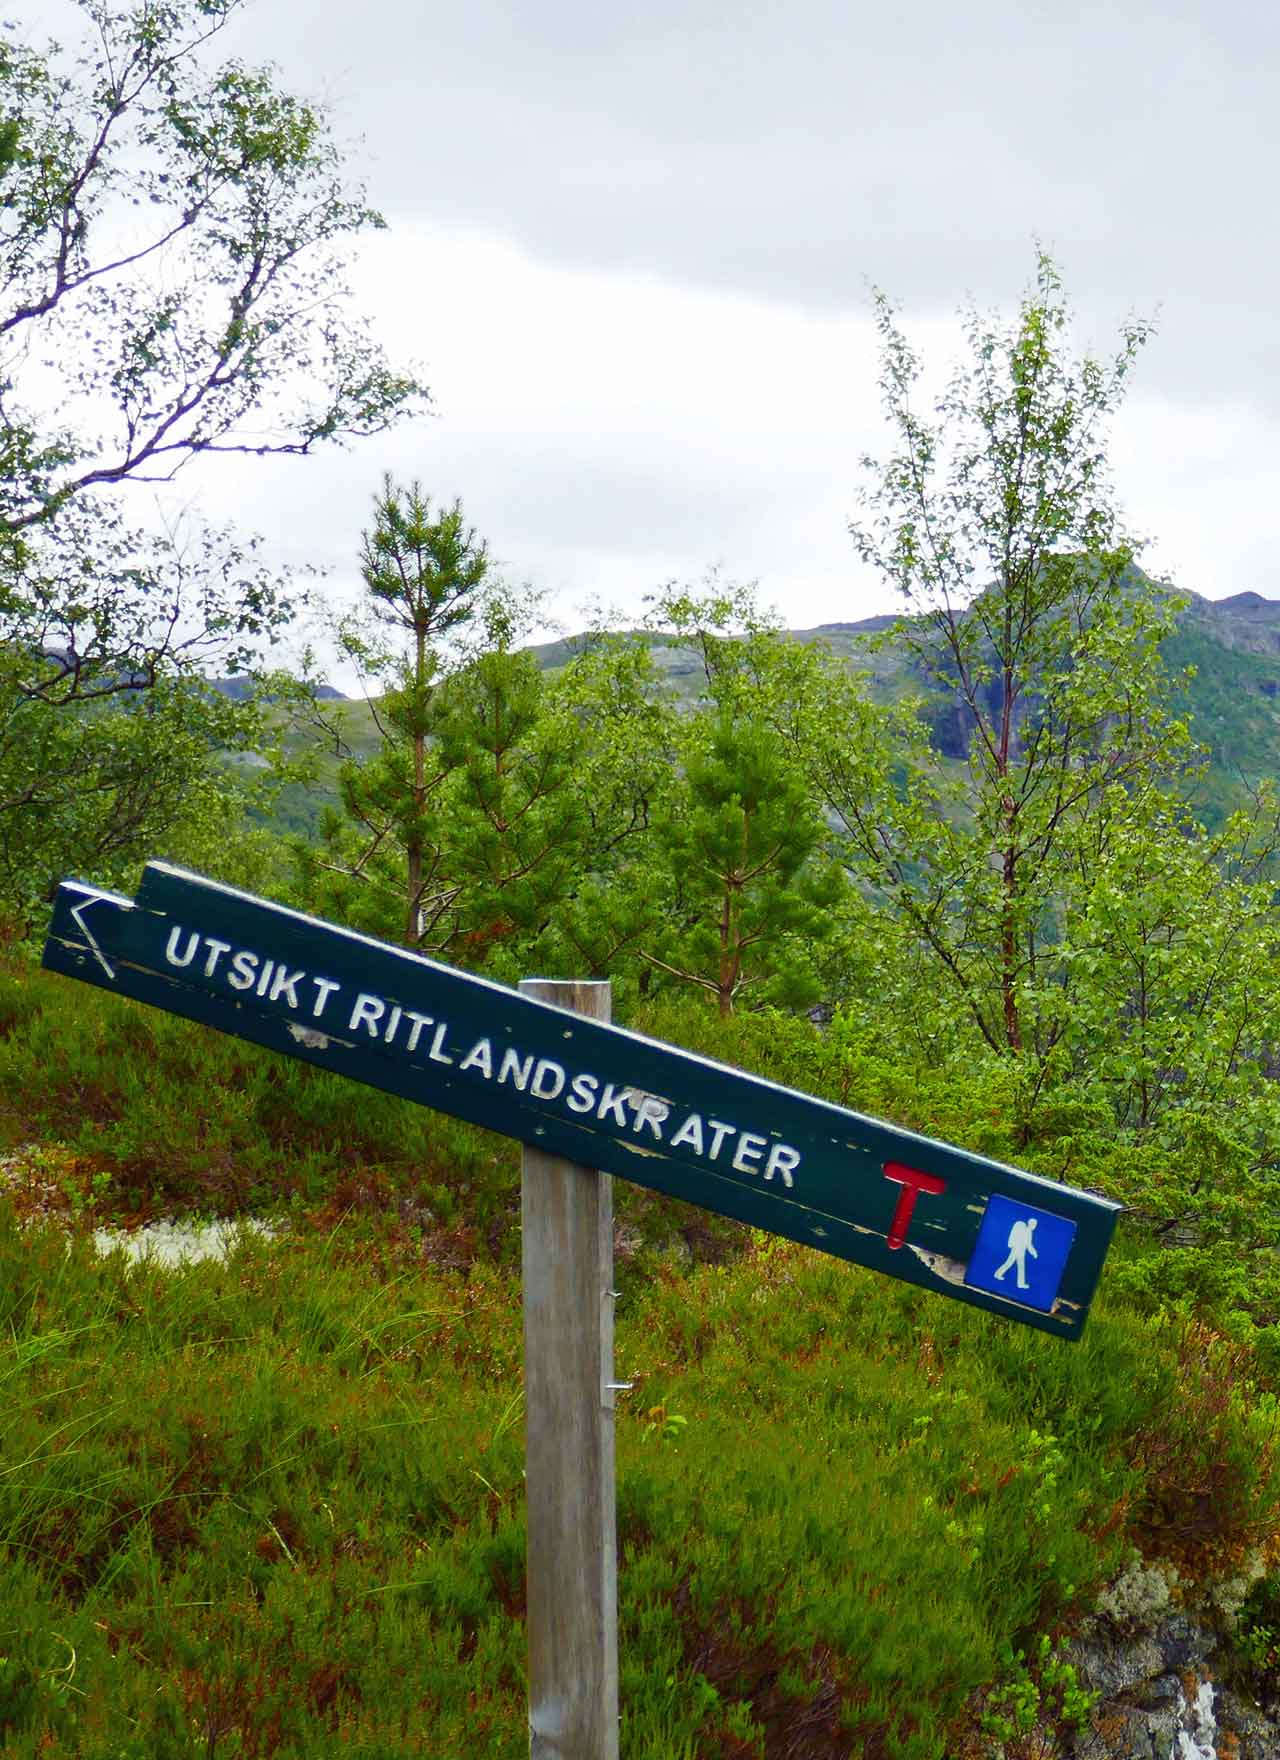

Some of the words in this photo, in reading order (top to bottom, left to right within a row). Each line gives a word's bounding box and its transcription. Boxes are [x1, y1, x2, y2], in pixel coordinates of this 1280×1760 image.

[166, 925, 340, 1017] UTSIKT
[349, 993, 801, 1188] RITLANDSKRATER
[881, 1161, 947, 1250] T
